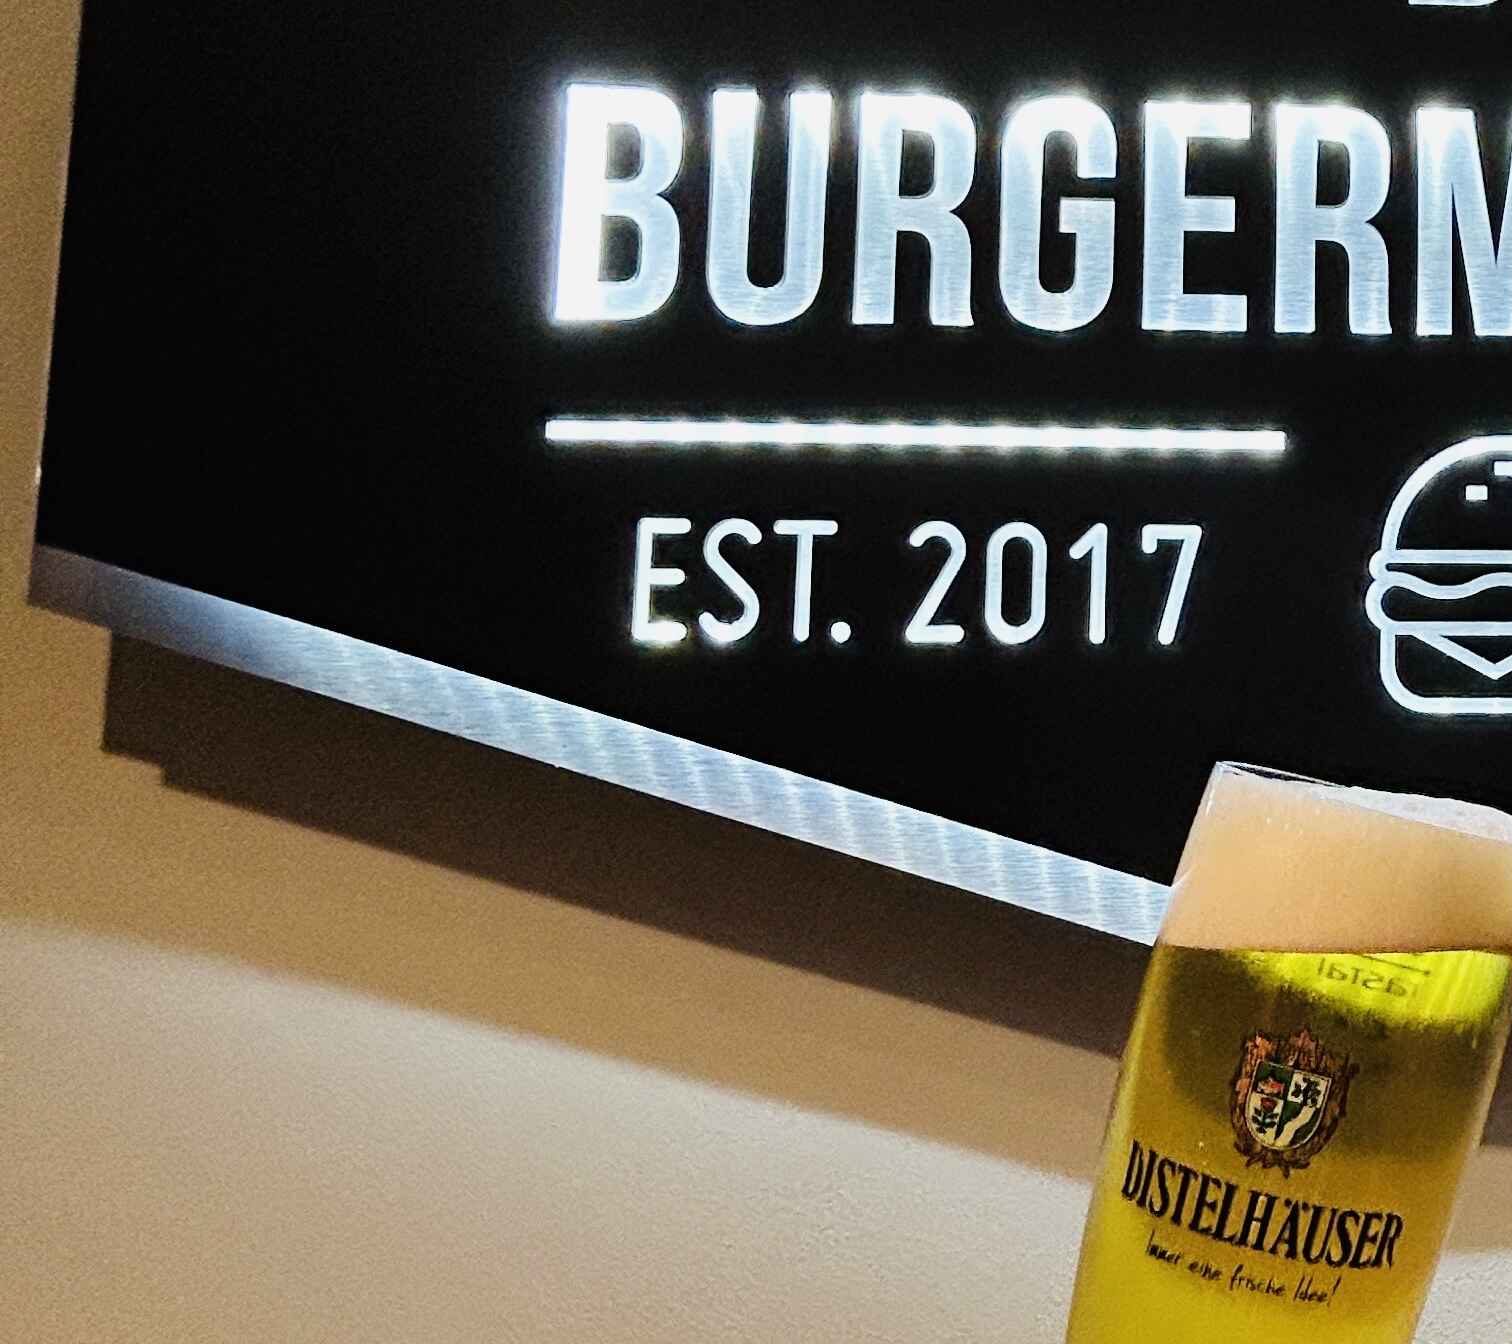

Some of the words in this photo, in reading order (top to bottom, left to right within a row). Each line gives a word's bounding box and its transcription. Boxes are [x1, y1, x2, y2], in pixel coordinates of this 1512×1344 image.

[630, 516, 852, 649] EST.
[903, 519, 1203, 647] 2017
[1120, 1138, 1404, 1271] DISTELHÄUSER
[1188, 1257, 1223, 1282] eine
[1229, 1264, 1287, 1297] frische
[1292, 1274, 1342, 1307] Idee!
